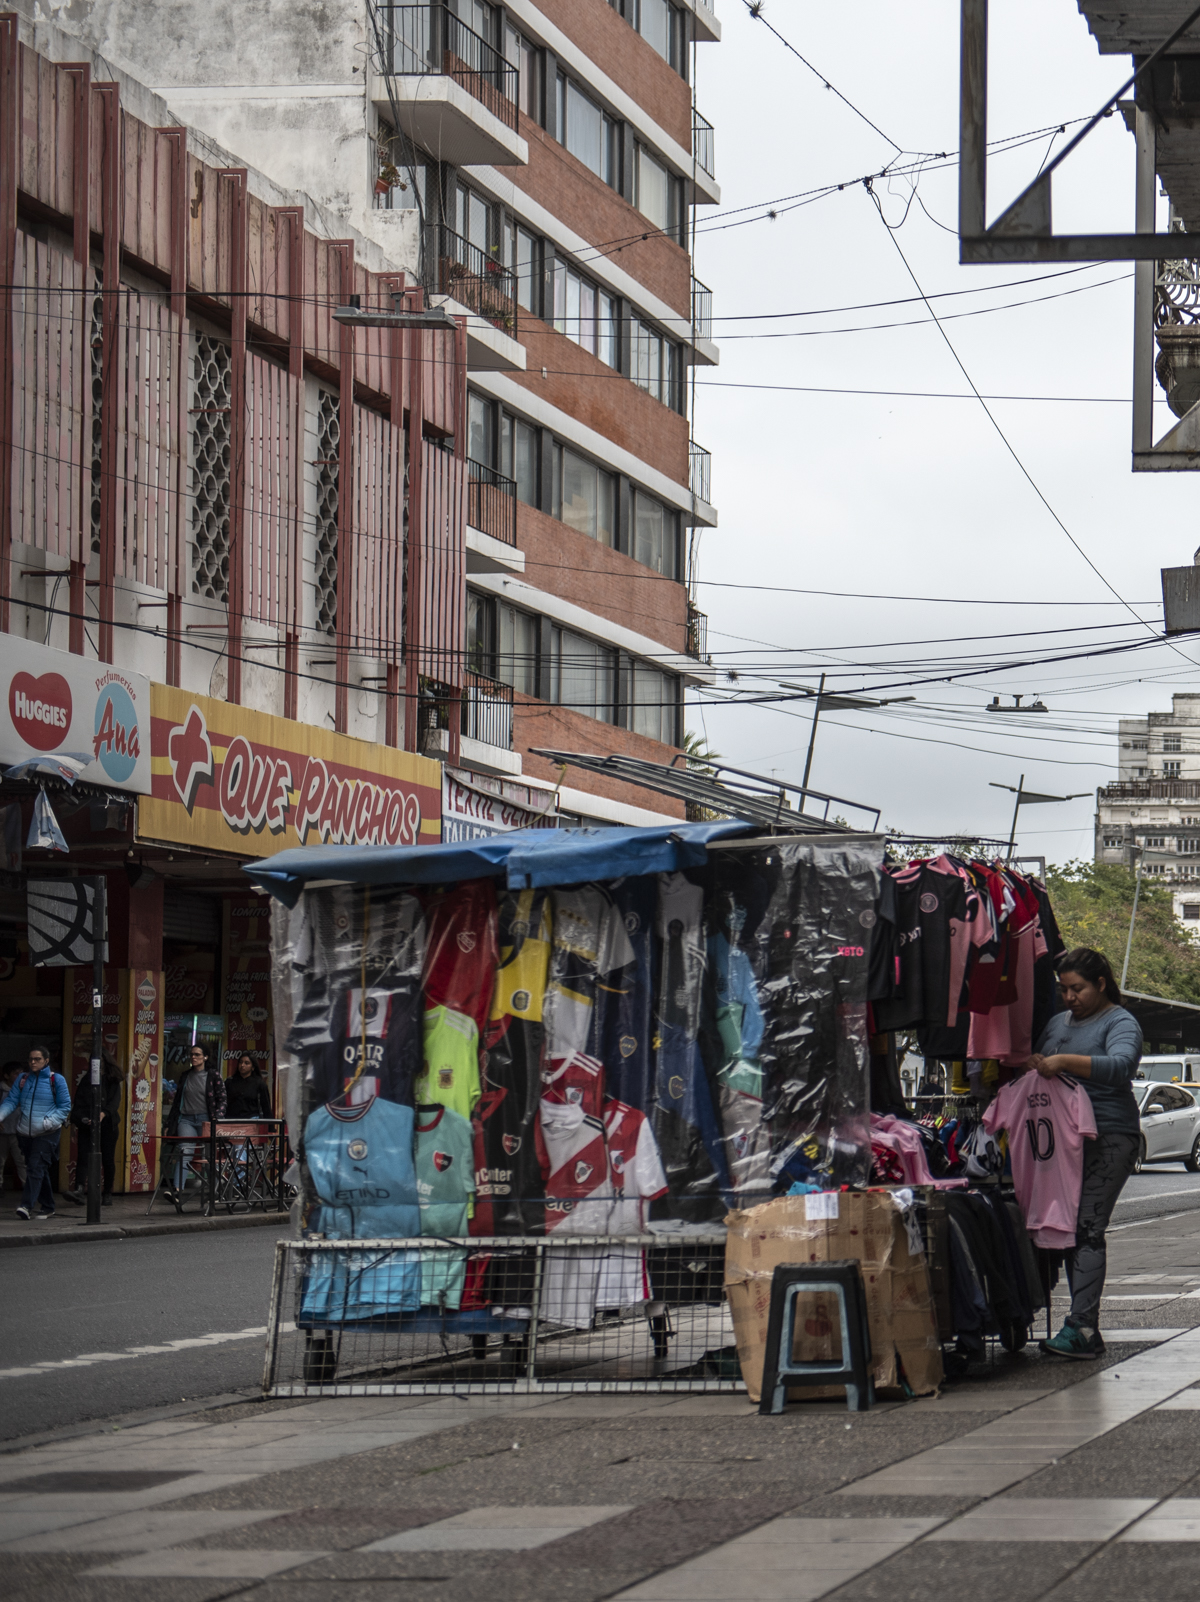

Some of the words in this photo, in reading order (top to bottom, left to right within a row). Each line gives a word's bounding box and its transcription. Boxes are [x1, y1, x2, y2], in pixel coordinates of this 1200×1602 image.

[95, 670, 137, 700] Perfumerías
[15, 690, 67, 728] HUGGIES
[92, 696, 140, 762] Ana
[220, 735, 294, 833] QUE
[295, 756, 420, 846] PANCHOS
[232, 907, 269, 917] LOMITO
[163, 963, 187, 982] UE
[137, 1010, 155, 1021] SUPER
[135, 1023, 157, 1034] PANCHO
[1026, 1093, 1052, 1108] ESSI
[1025, 1117, 1055, 1162] 10
